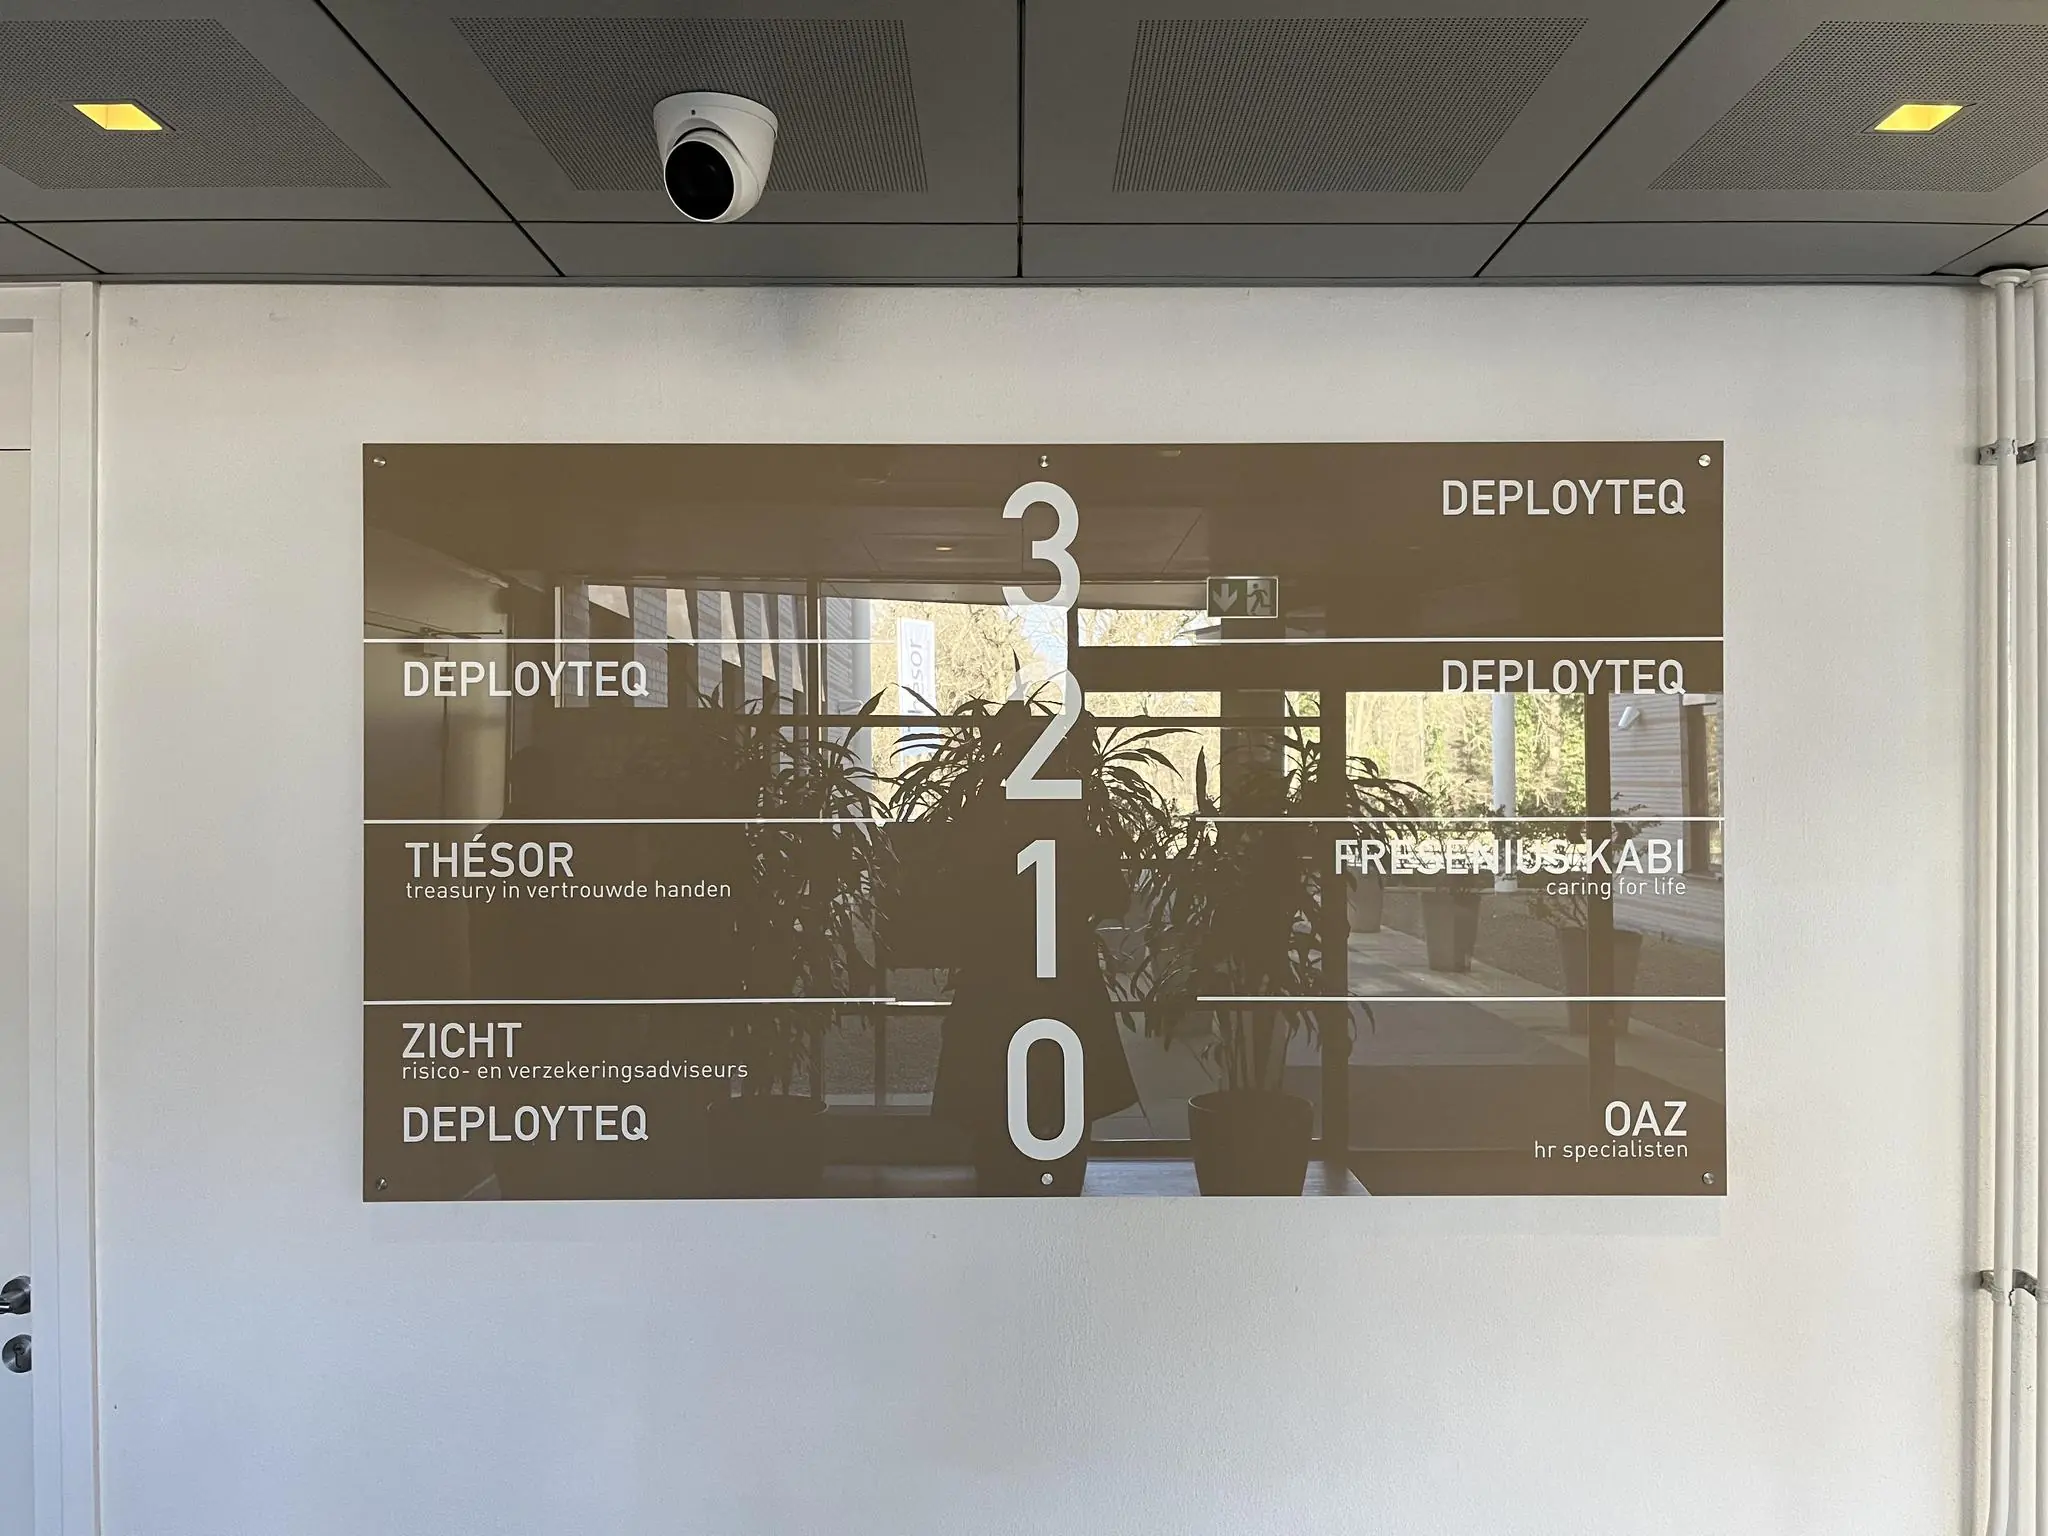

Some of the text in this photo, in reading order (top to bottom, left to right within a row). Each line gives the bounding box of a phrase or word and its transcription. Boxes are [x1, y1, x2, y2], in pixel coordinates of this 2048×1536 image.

[1442, 479, 1686, 516] DEPLOYTEQ
[1002, 481, 1080, 614] 3
[404, 660, 649, 697] DEPLOYTEQ
[1442, 659, 1686, 695] DEPLOYTEQ
[1005, 665, 1082, 800] 2
[405, 834, 574, 878] THÉSOR
[1335, 838, 1684, 875] FRESENIUS KABI
[406, 880, 731, 903] treasury in vertrouwde handen
[1546, 876, 1686, 900] caring for life
[1017, 839, 1056, 978] 1
[402, 1022, 522, 1058] ZICHT
[402, 1060, 749, 1083] risico- en verzekeringsadviseurs
[1007, 1018, 1084, 1161] 0
[403, 1104, 649, 1143] DEPLOYTEQ
[1605, 1100, 1687, 1137] OAZ
[1534, 1139, 1688, 1163] hr specialisten
